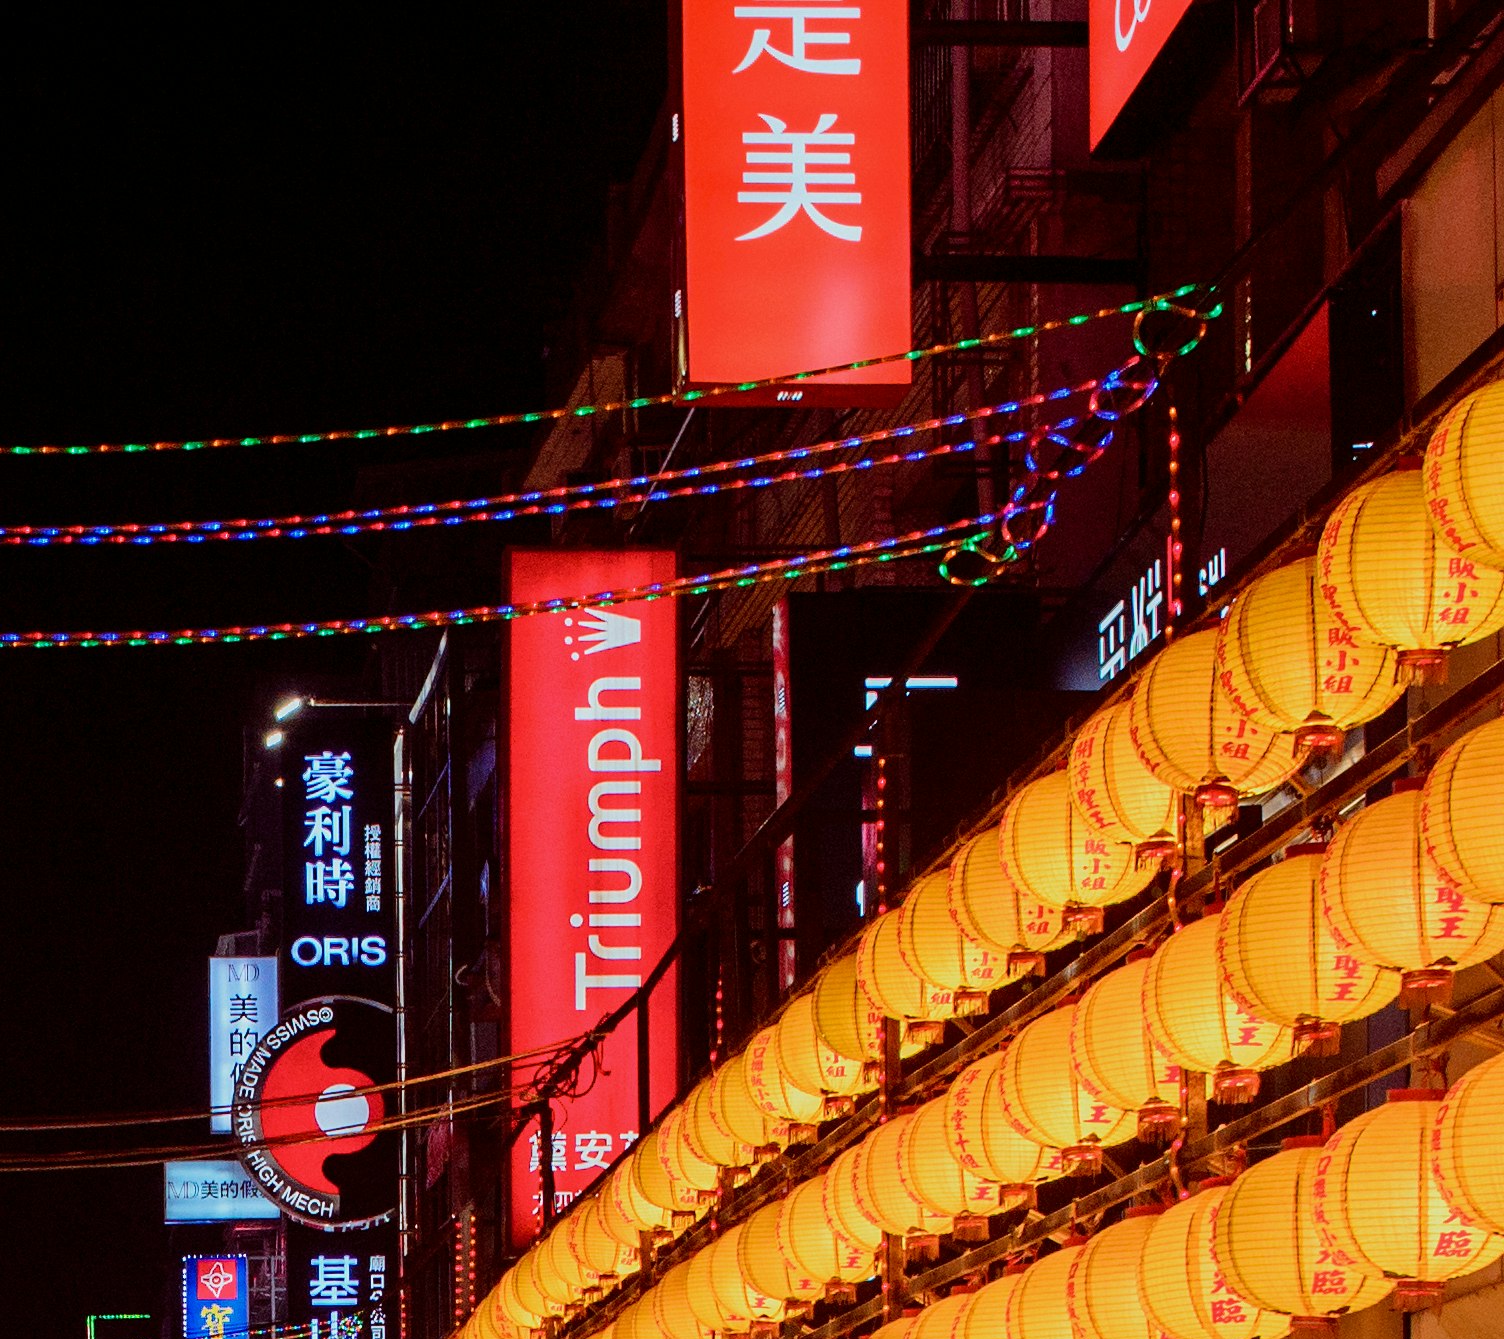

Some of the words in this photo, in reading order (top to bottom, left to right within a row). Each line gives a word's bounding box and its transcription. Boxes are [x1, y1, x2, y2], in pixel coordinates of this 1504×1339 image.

[302, 751, 355, 908] 豪利時
[570, 675, 661, 1012] Triumph
[364, 823, 382, 912] 授權經銷商
[292, 936, 386, 967] ORIS
[267, 1007, 320, 1050] SWISS
[238, 1047, 271, 1099] MADE
[238, 1103, 257, 1147] ORIS
[200, 1178, 268, 1200] 美的假
[247, 1150, 285, 1194] HIGH
[281, 1185, 335, 1219] MECH
